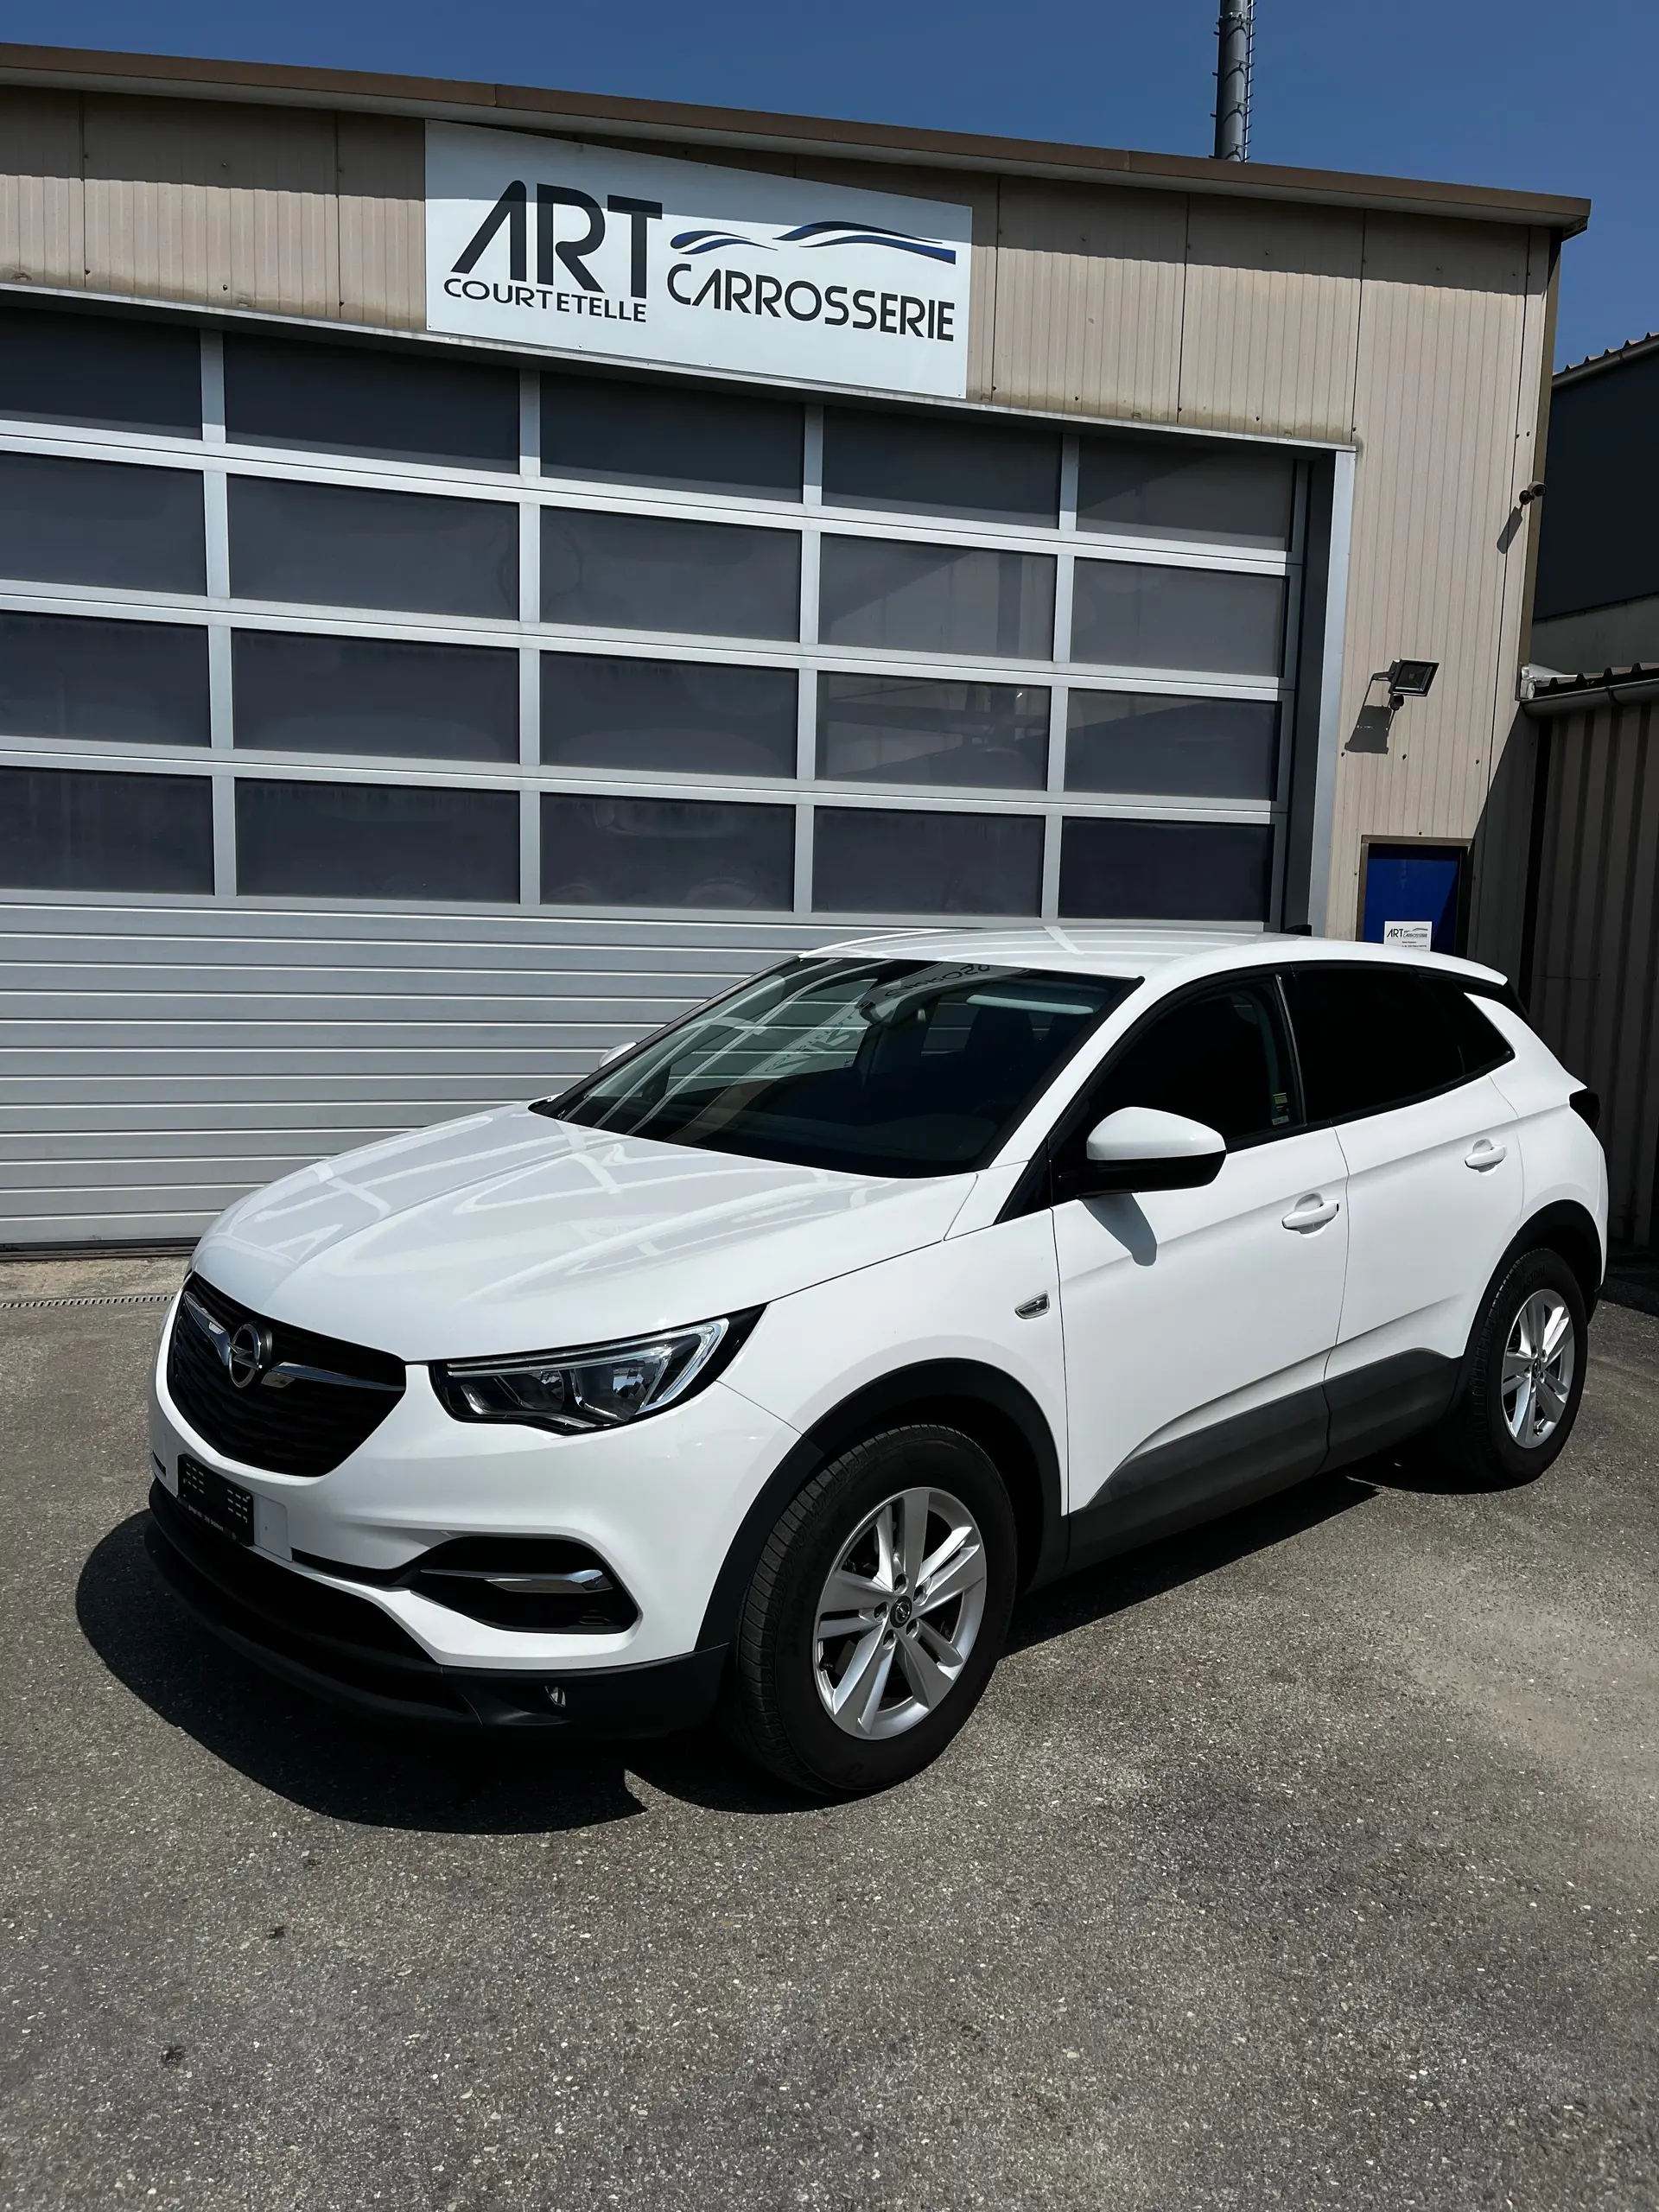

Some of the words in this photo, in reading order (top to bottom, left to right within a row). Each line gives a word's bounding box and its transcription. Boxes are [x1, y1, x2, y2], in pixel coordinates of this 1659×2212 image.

[450, 180, 663, 299] ART
[443, 277, 646, 323] COURTETELLE
[667, 263, 955, 342] CARROSSERIE
[1387, 929, 1403, 938] ART
